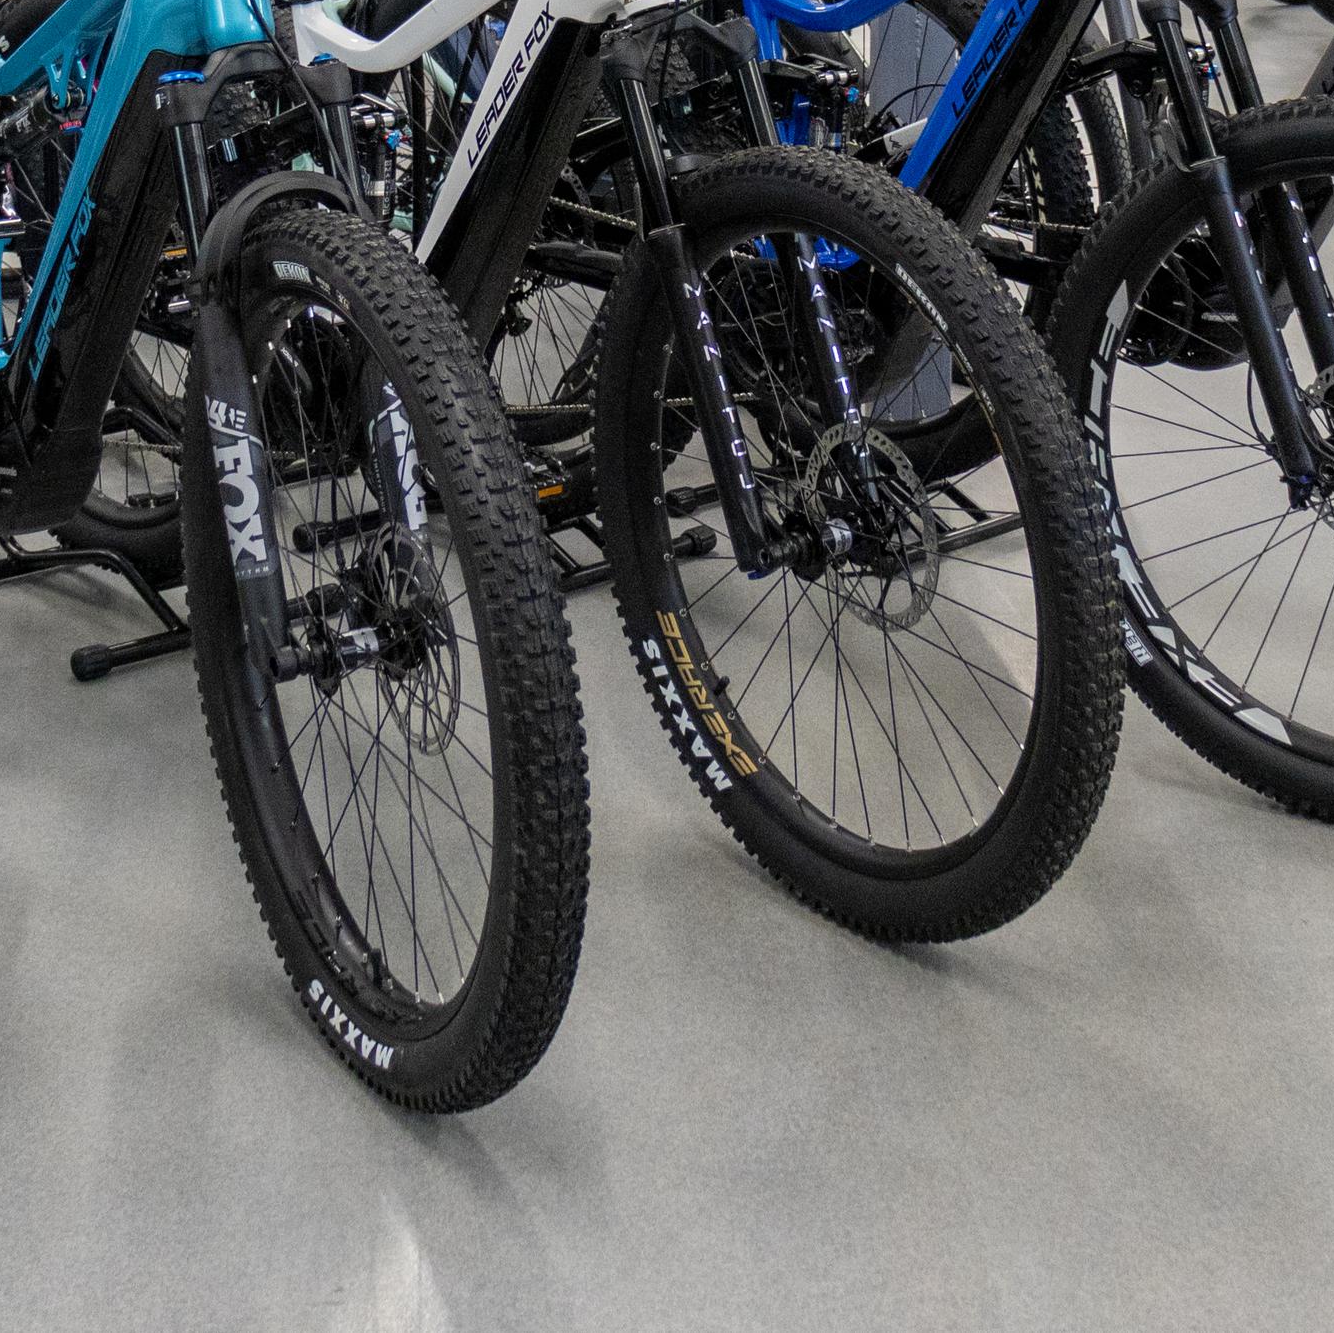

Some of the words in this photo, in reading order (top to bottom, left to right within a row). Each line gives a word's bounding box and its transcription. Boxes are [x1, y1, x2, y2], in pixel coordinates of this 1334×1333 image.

[468, 53, 526, 169] LEADER
[523, 0, 556, 61] FOX
[951, 7, 1020, 119] LEADER
[29, 243, 76, 383] LEADER
[70, 187, 97, 254] FOX
[683, 282, 755, 489] MANITOU
[213, 438, 267, 567] FOX
[1119, 615, 1154, 667] REK
[642, 639, 733, 792] MAXXIS
[308, 979, 395, 1069] MAXXIS
